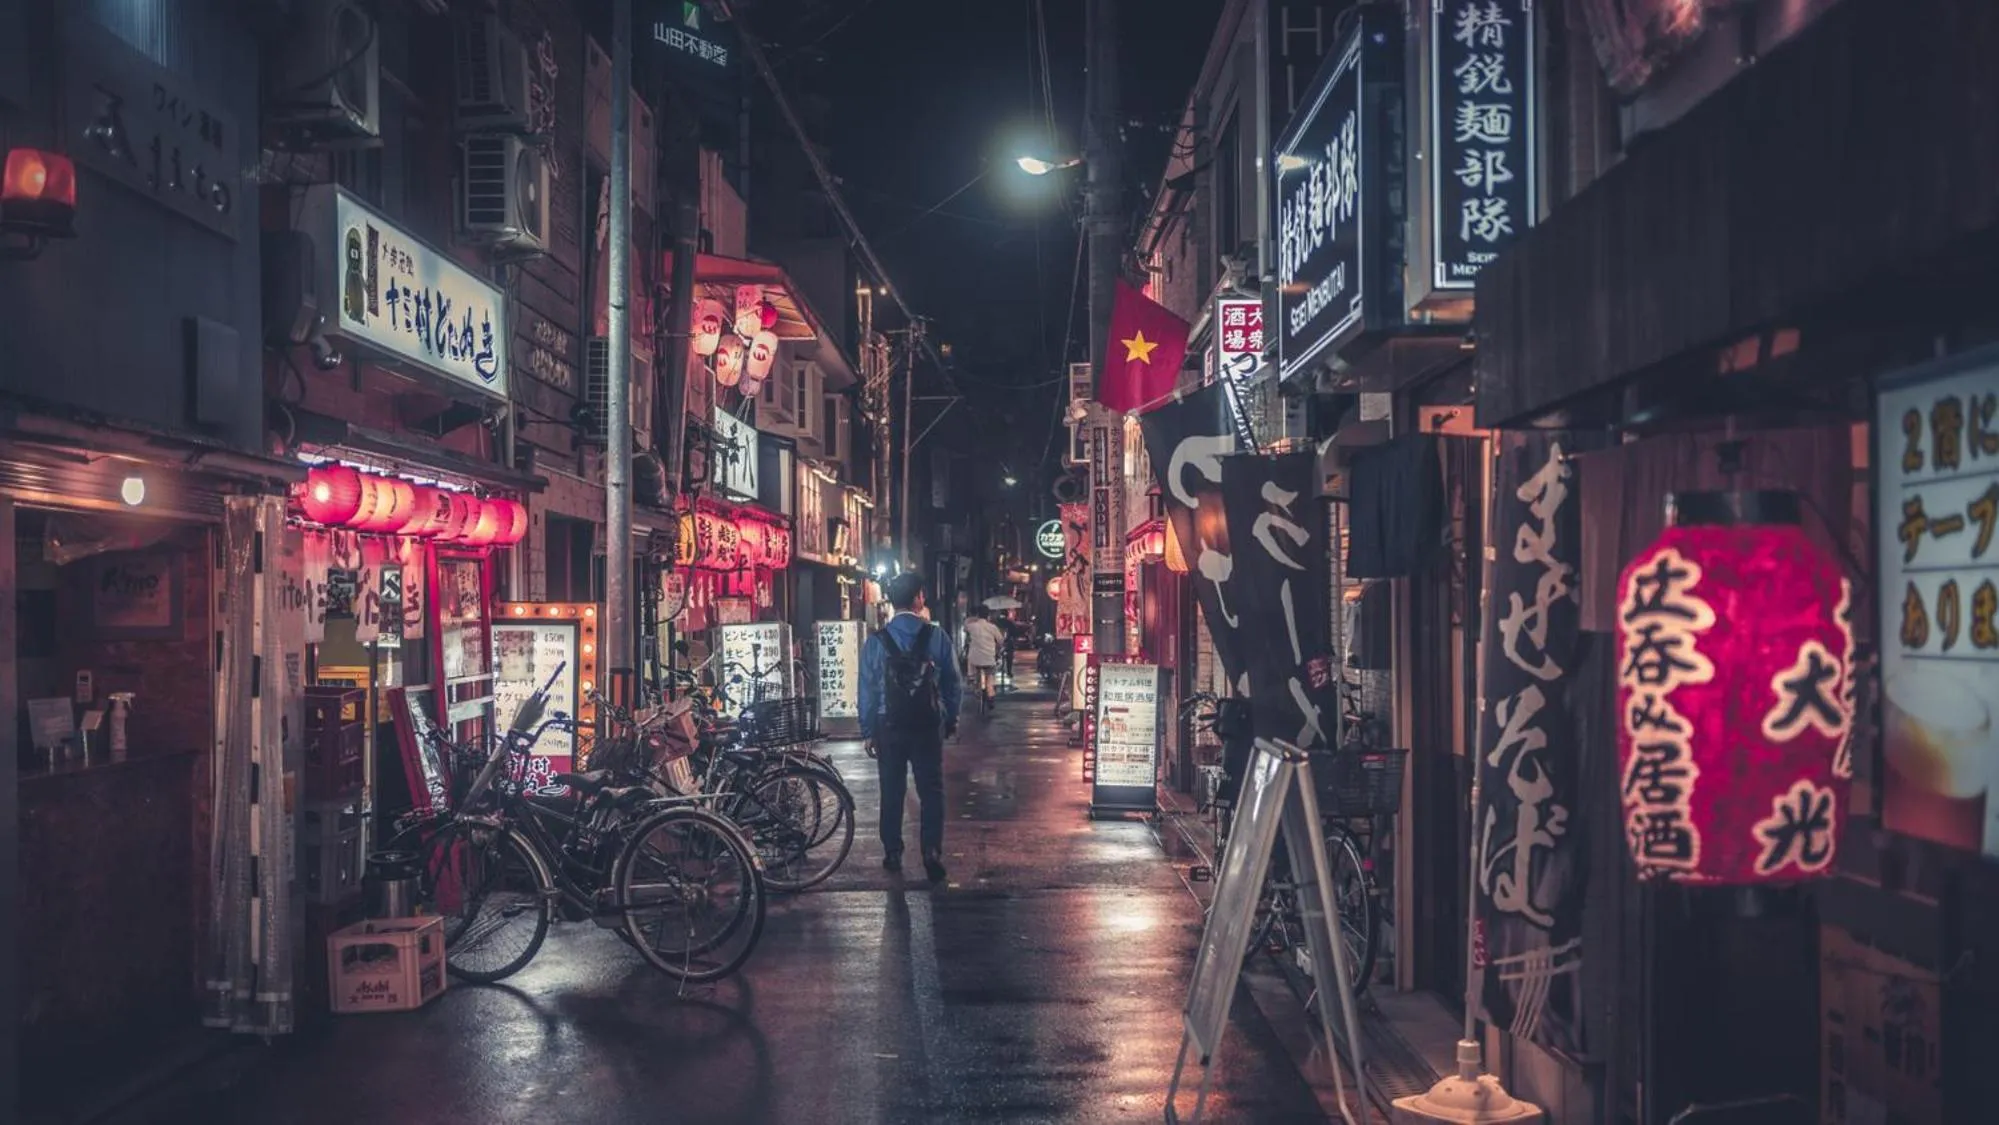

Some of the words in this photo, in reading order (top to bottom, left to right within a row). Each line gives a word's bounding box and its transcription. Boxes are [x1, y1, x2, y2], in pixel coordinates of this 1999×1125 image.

[654, 22, 728, 67] 山田不動産
[1620, 549, 1714, 880] 立呑み居酒
